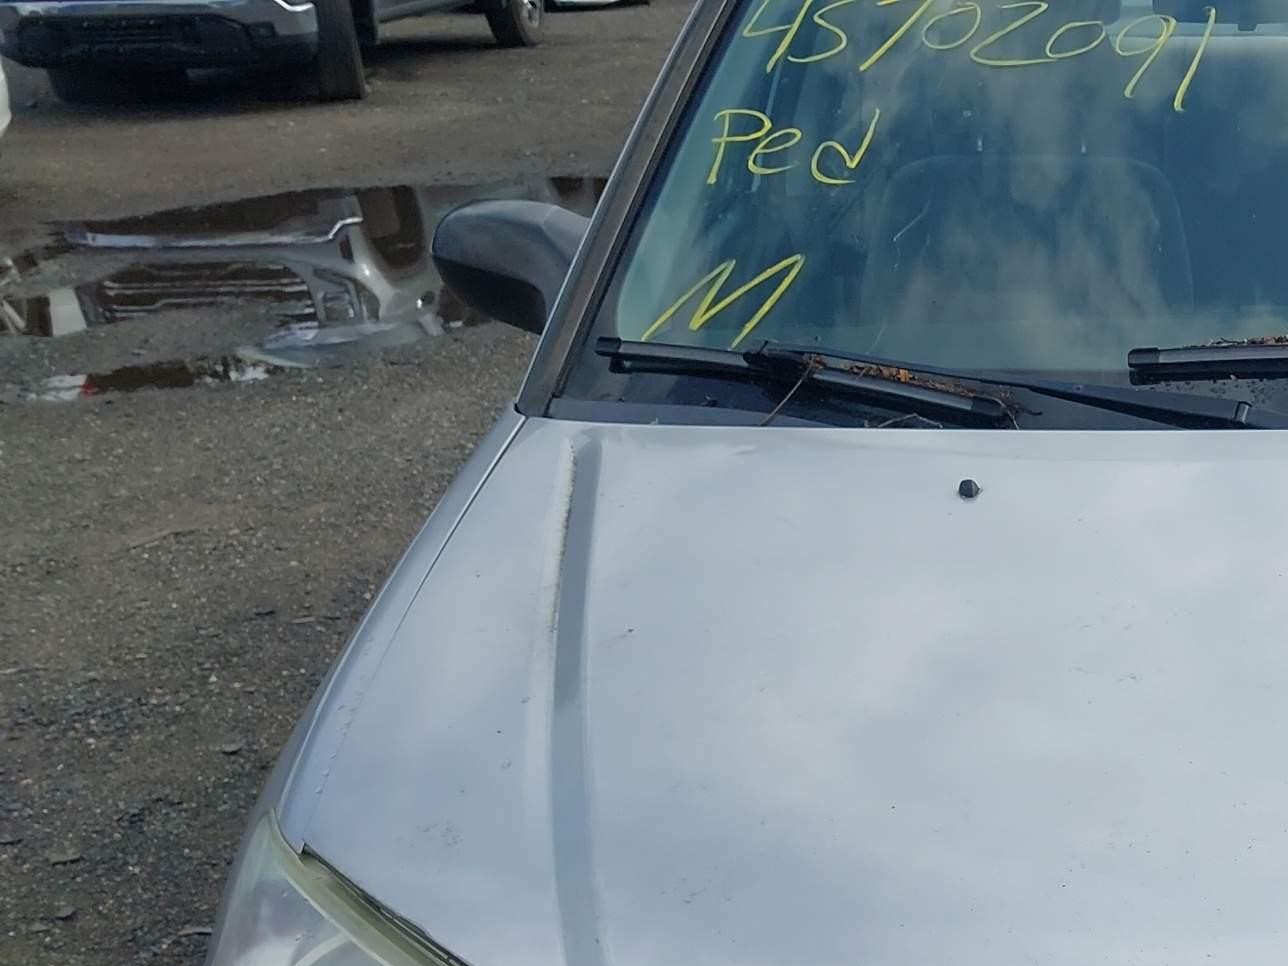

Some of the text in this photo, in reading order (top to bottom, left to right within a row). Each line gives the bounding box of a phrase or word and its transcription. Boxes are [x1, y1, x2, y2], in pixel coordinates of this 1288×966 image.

[743, 0, 1216, 112] 45702091
[711, 107, 881, 185] Ped
[640, 253, 806, 351] M
